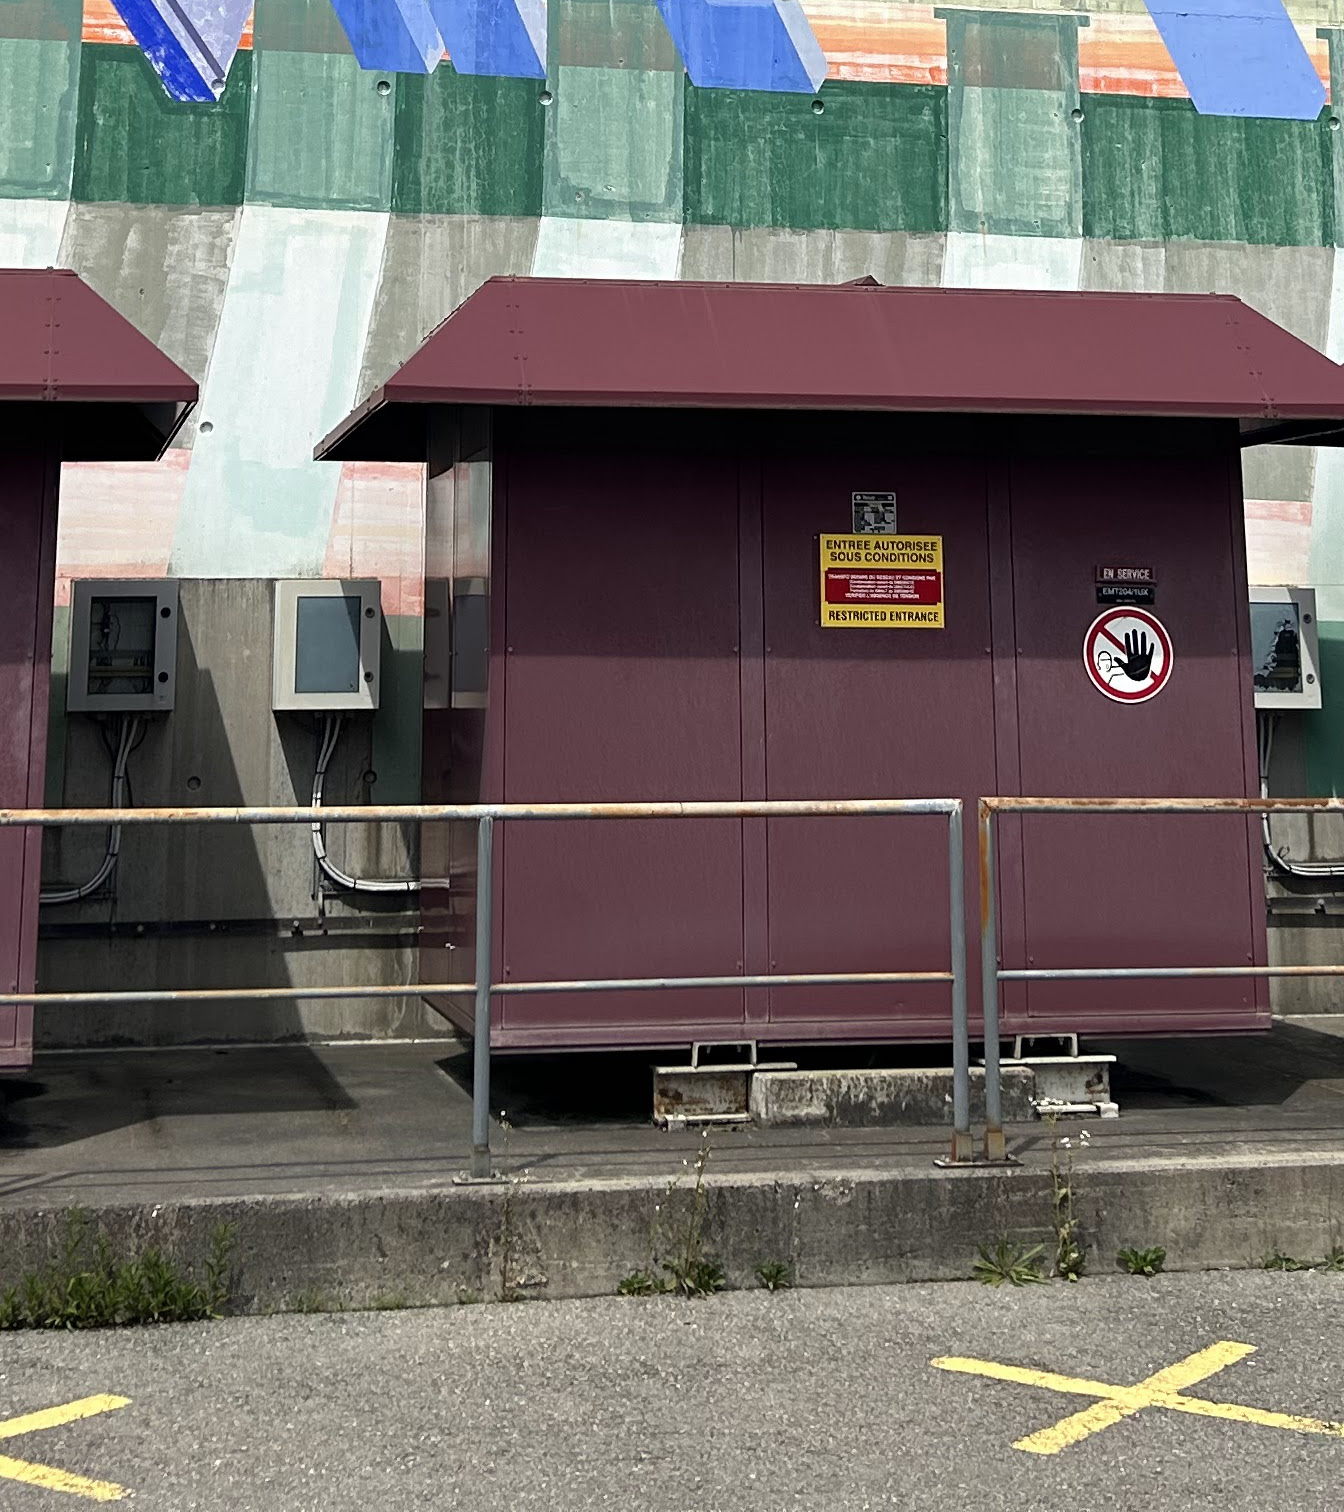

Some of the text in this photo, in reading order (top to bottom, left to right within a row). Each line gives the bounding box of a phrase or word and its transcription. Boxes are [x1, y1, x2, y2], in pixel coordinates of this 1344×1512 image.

[826, 540, 937, 551] ENTREE AUTORISEE
[830, 552, 934, 563] SOUS CONDITIONS
[1103, 568, 1150, 579] EN SERVICE
[828, 610, 939, 622] RESTRICTED ENTRANCE
